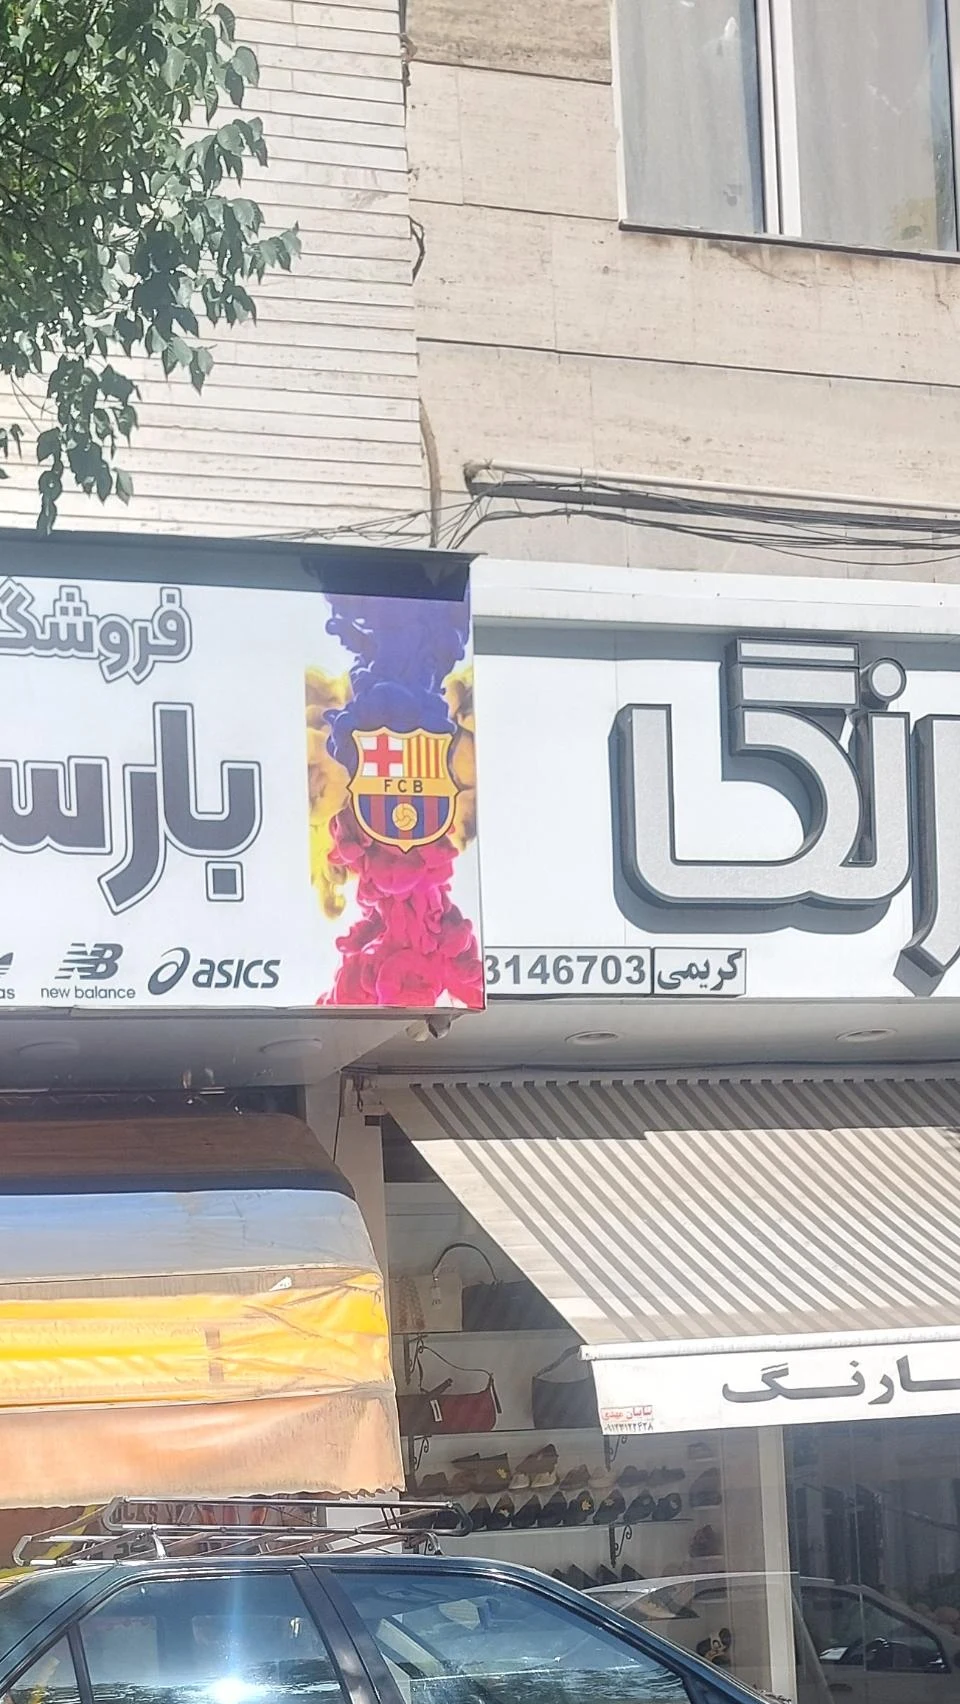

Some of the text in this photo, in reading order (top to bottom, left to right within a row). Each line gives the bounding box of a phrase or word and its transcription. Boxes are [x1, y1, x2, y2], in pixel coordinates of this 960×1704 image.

[384, 779, 424, 794] FCB
[657, 950, 744, 991] کریمی
[41, 985, 136, 999] new balance
[721, 1354, 960, 1406] ارنگ
